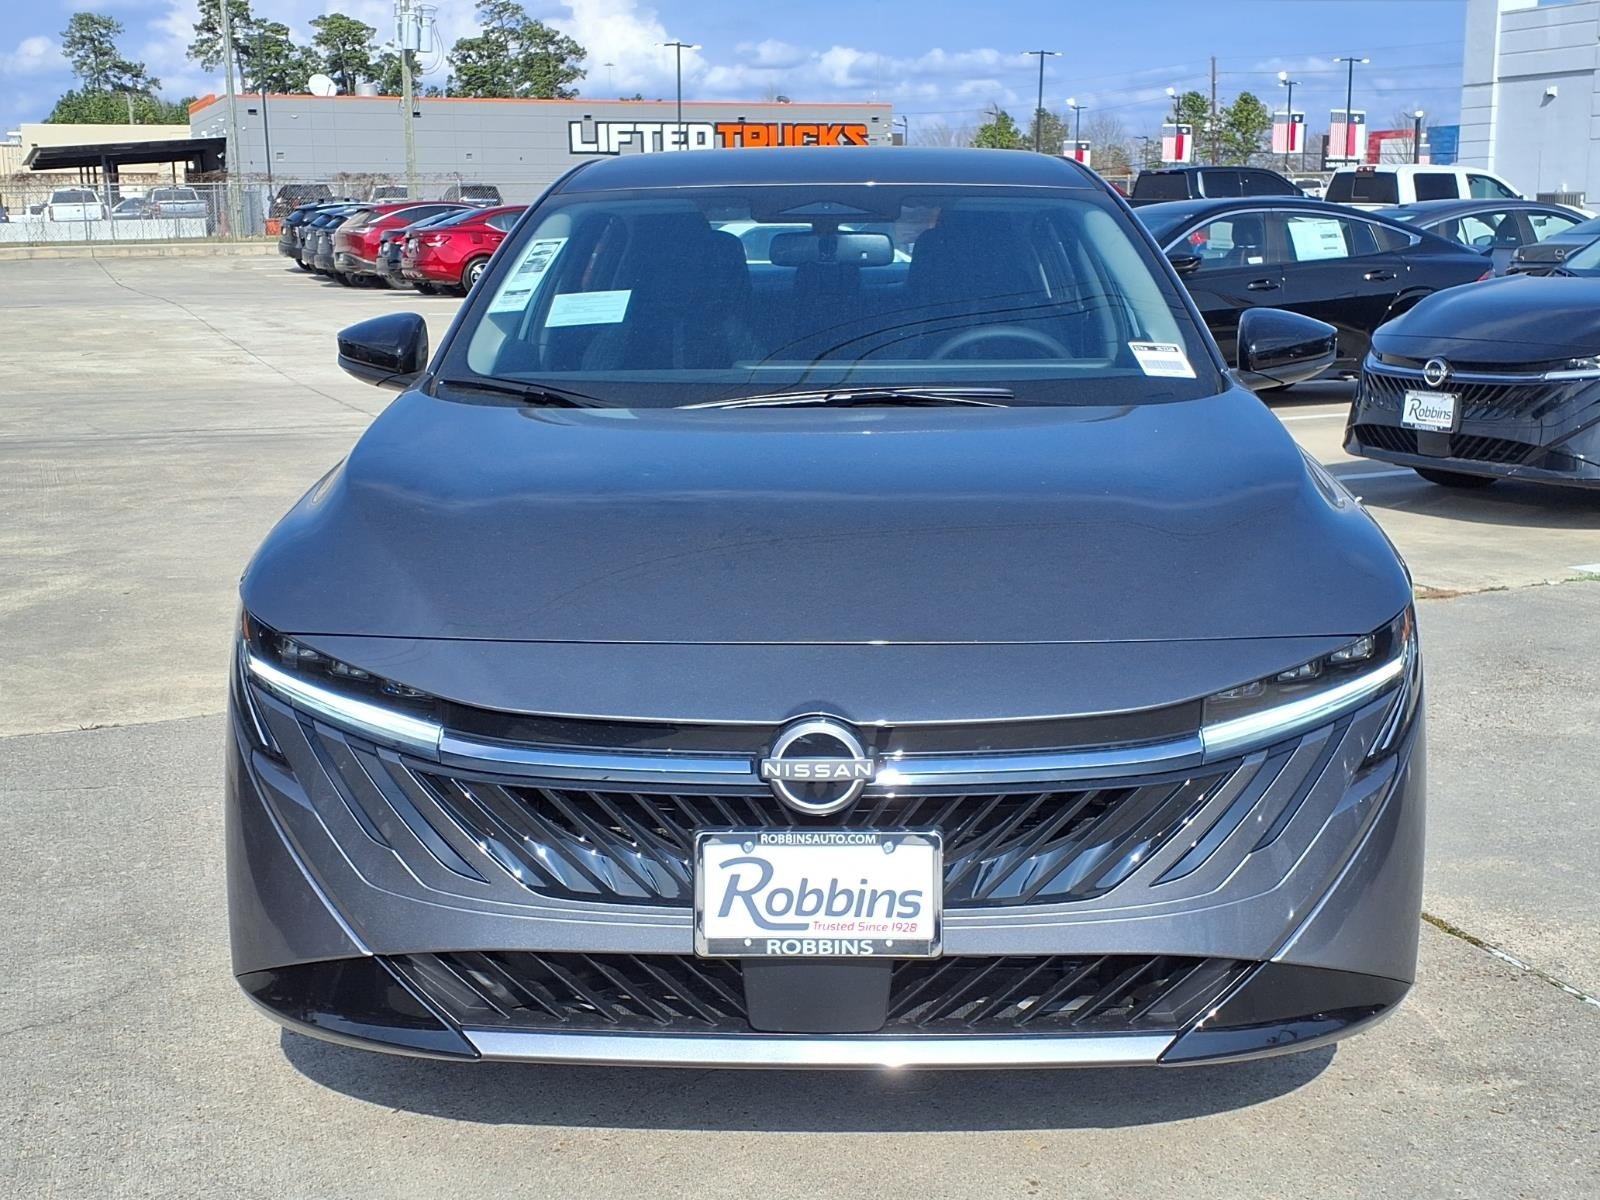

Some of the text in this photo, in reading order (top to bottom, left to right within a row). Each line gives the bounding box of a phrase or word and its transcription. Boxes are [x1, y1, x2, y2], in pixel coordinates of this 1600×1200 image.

[569, 121, 870, 155] LIFTED TRUCKS
[1409, 398, 1452, 422] Robbins
[763, 762, 871, 777] NISSAN
[760, 833, 876, 845] ROBBINSAUTO.COM
[717, 856, 923, 931] Robbins
[813, 920, 918, 933] Trusted Since 1928
[766, 939, 874, 955] ROBBINS
